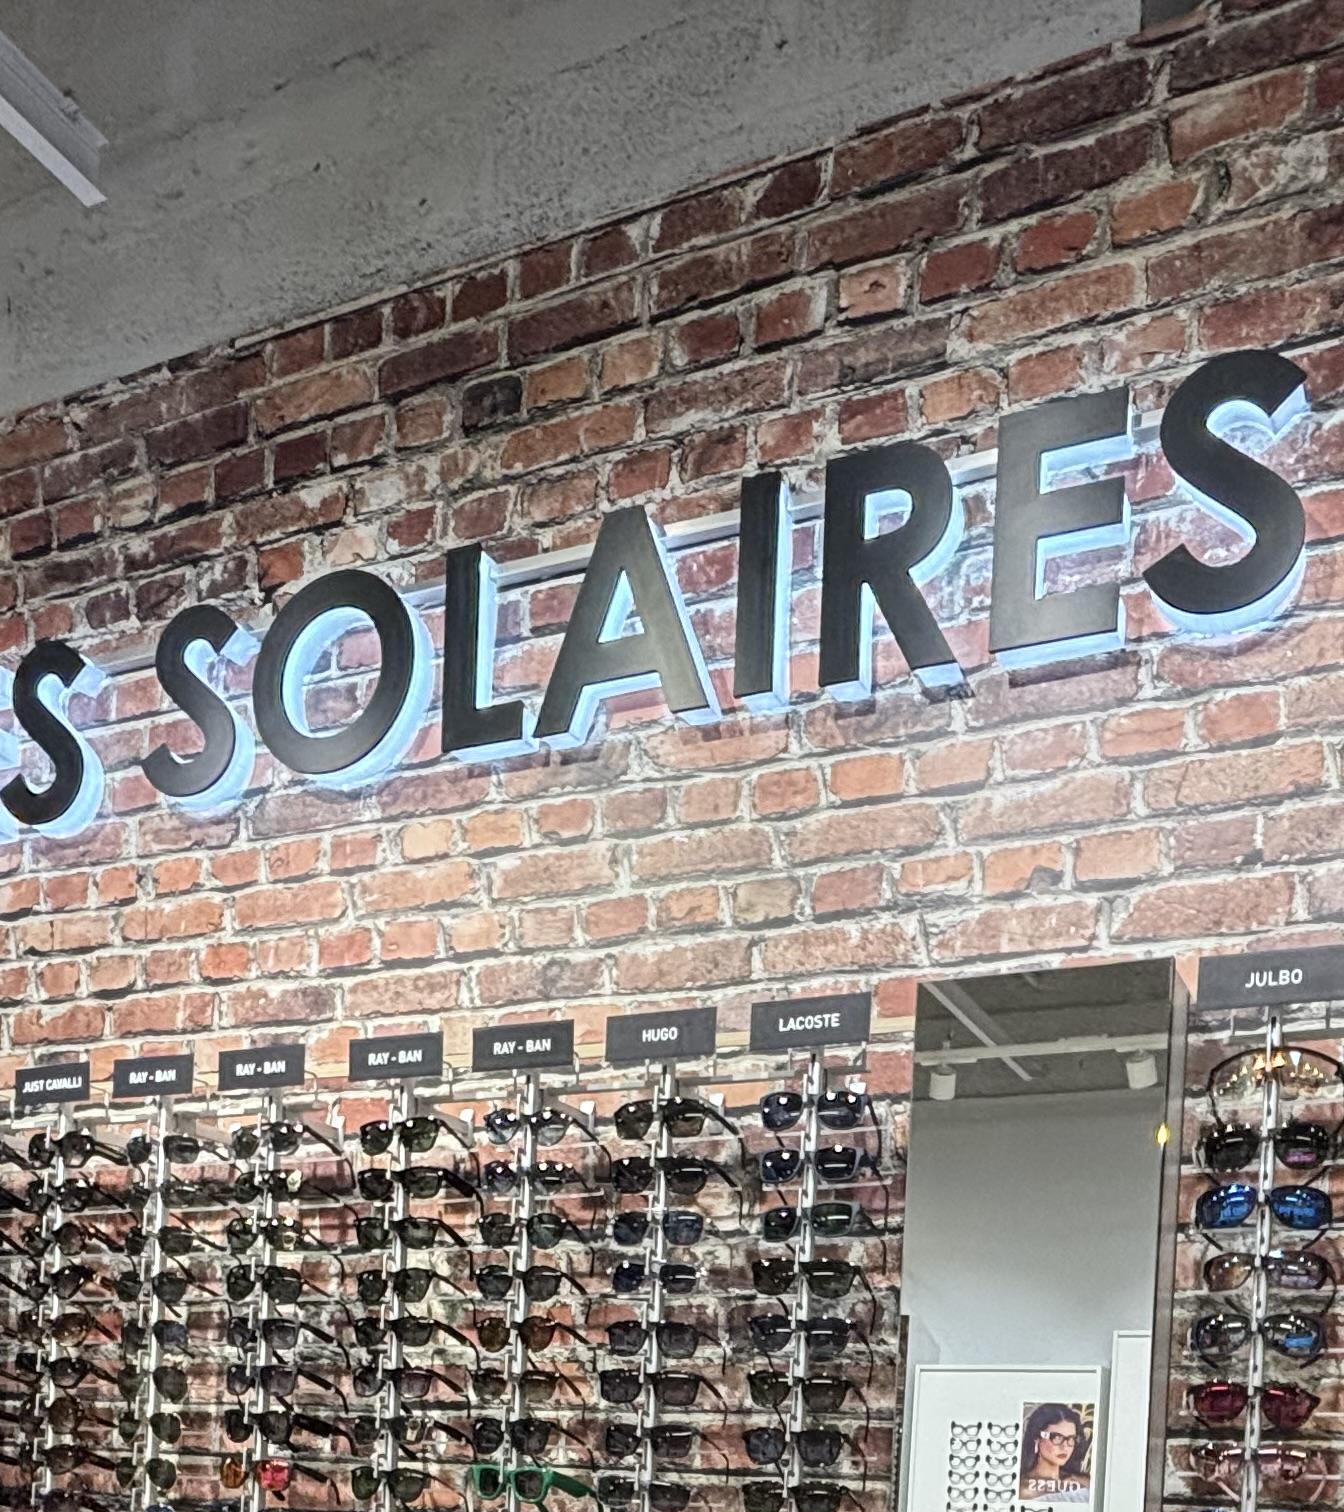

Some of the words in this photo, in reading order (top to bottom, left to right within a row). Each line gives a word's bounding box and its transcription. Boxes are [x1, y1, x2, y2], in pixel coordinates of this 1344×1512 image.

[140, 349, 1310, 799] SOLAIRES
[1244, 968, 1304, 989] JULBO
[778, 1012, 842, 1033] LACOSTE
[641, 1025, 679, 1043] HUGO
[492, 1040, 517, 1056] RAY
[525, 1038, 552, 1053] BAN
[367, 1051, 391, 1067] RAY
[397, 1048, 423, 1064] BAN
[128, 1071, 148, 1085] RAY
[154, 1068, 177, 1083] BAN
[235, 1062, 257, 1077] RAY
[262, 1059, 286, 1075] BAN
[22, 1079, 45, 1093] JUST
[45, 1075, 83, 1091] CAVALLI
